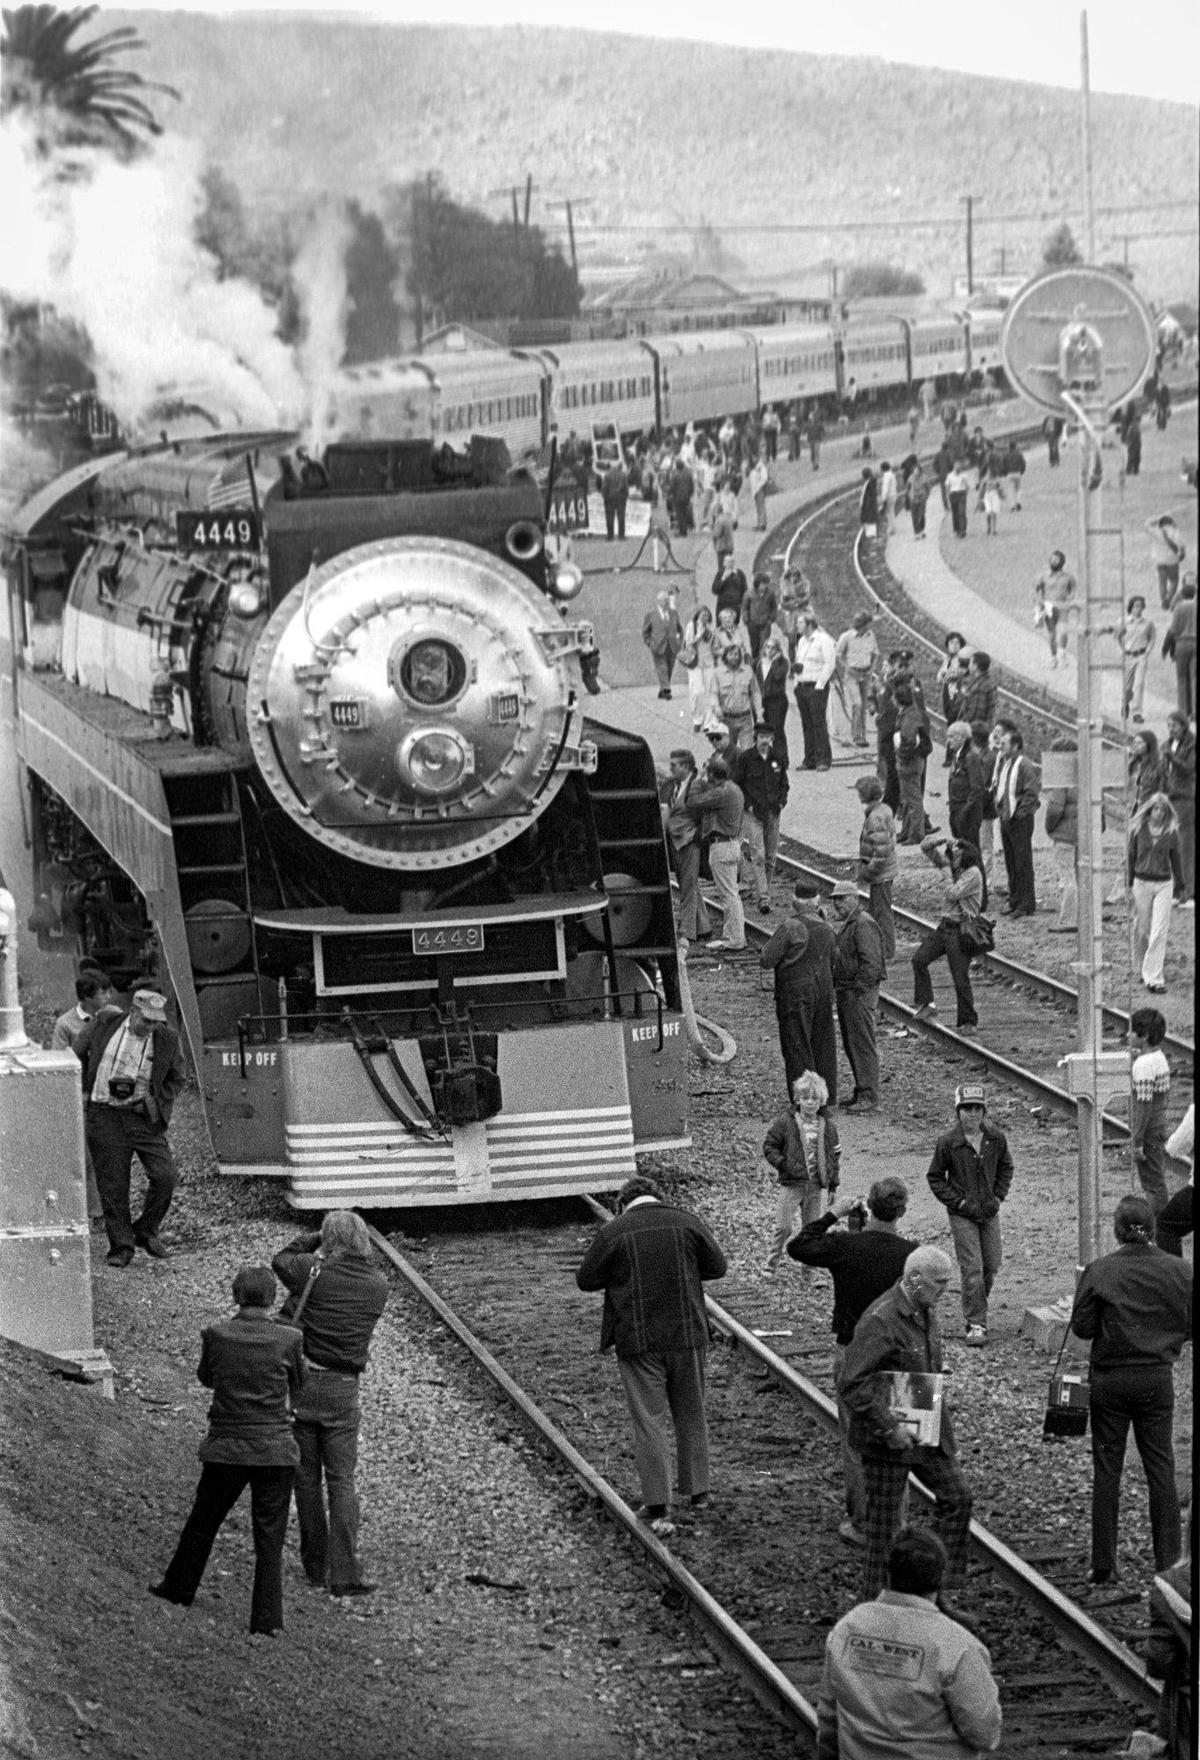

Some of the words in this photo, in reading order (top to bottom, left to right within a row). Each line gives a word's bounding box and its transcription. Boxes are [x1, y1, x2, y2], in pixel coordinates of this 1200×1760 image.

[548, 499, 586, 524] 4449
[194, 520, 251, 544] 4449
[334, 706, 358, 722] 4449
[418, 928, 478, 949] 4449
[632, 1025, 658, 1042] KEEP
[662, 1022, 680, 1037] OFF
[255, 1051, 277, 1066] OFF
